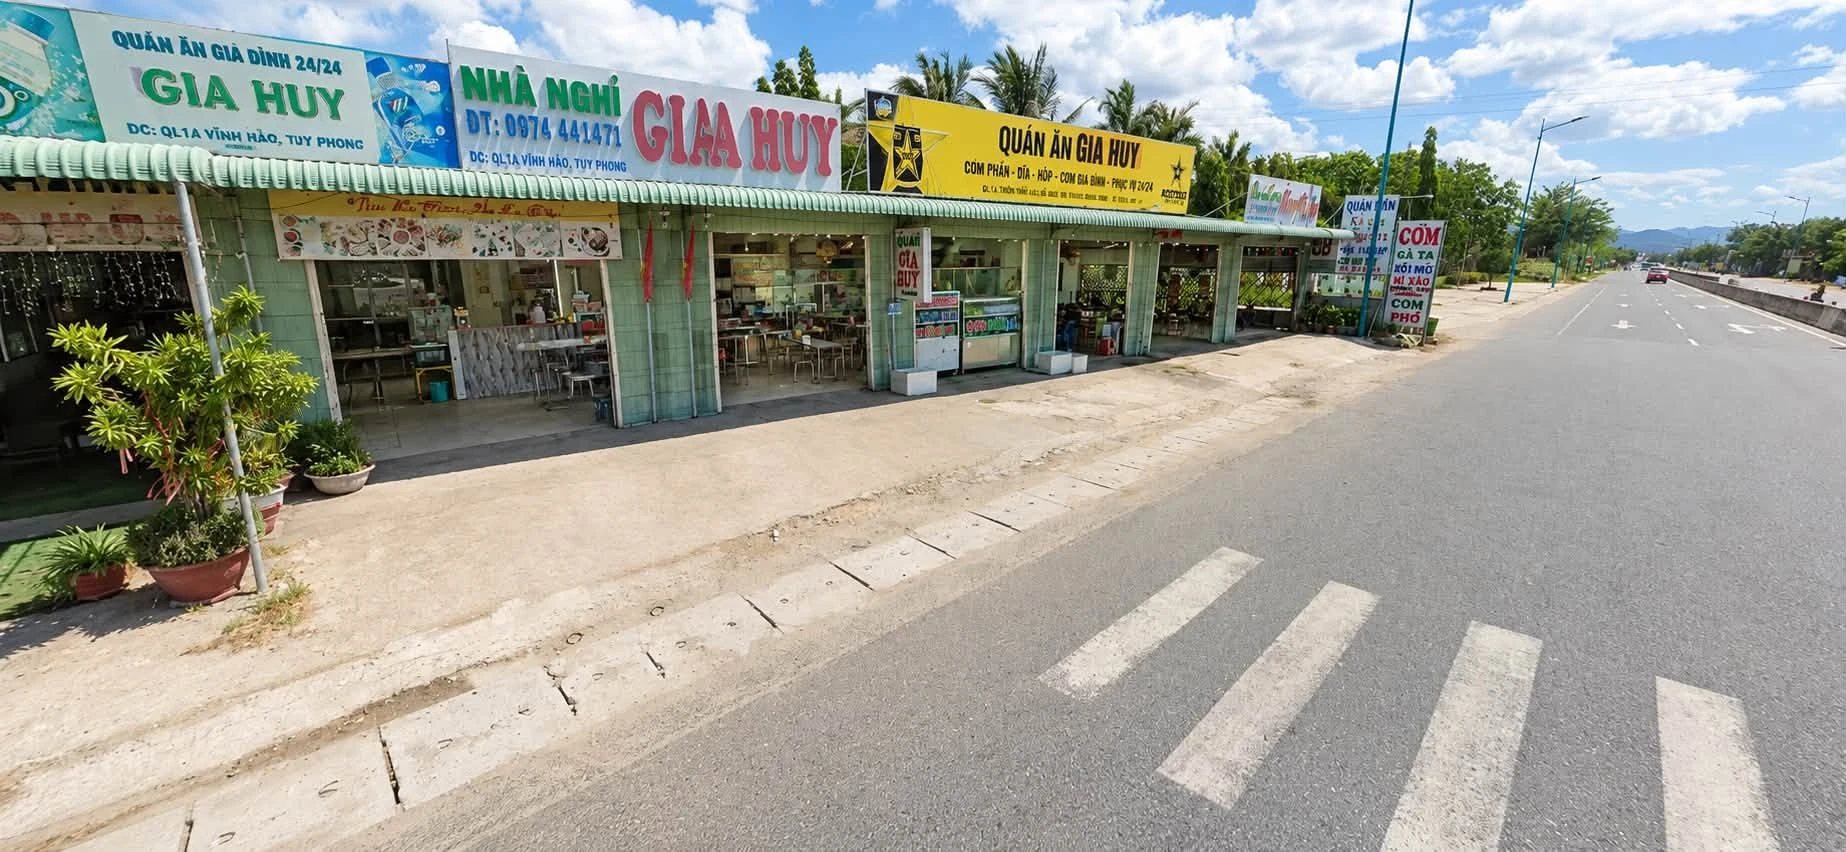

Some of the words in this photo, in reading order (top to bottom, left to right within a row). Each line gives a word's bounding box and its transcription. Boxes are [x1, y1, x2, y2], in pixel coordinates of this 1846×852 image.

[179, 36, 207, 58] ĂN
[295, 55, 342, 76] 24/24
[141, 67, 240, 112] GIA
[251, 79, 344, 120] HUY
[460, 65, 537, 107] NHÀ
[160, 125, 202, 139] QL1A
[285, 135, 312, 147] TUY
[317, 136, 364, 150] PHONG
[505, 113, 552, 141] 0974
[559, 118, 622, 147] 441471
[750, 106, 838, 177] HUY
[999, 124, 1045, 157] QUÁN
[1049, 129, 1072, 160] ĂN
[1076, 133, 1103, 165] GIA
[1107, 138, 1140, 169] HUY
[574, 158, 593, 169] TUY
[596, 160, 627, 172] PHONG
[1418, 250, 1434, 260] TA
